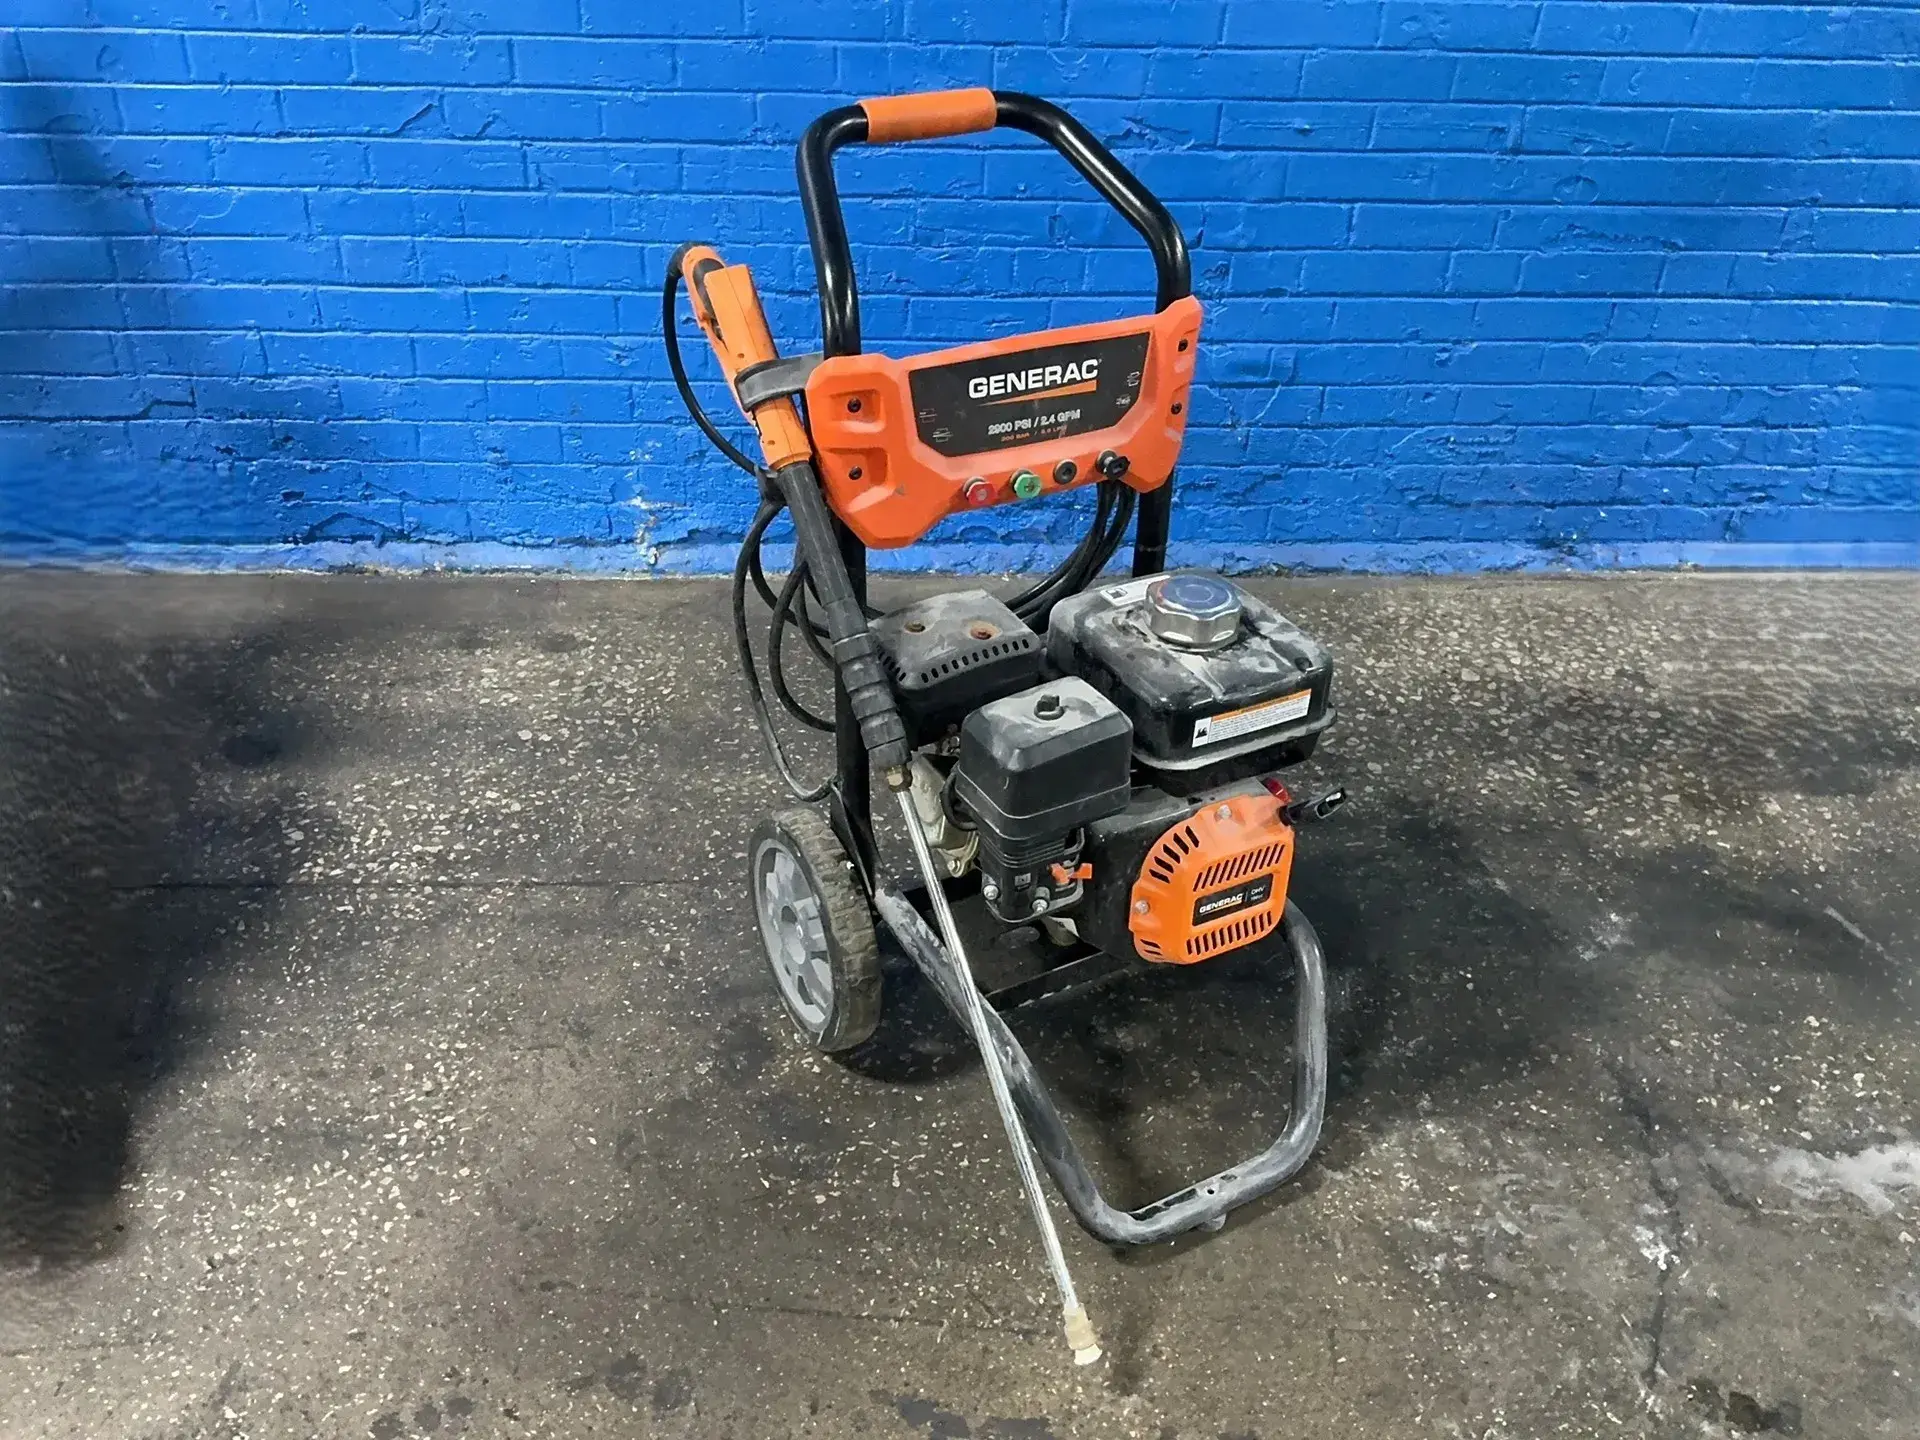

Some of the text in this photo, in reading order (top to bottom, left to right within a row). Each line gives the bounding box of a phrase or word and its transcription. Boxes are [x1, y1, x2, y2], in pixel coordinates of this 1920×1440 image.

[968, 358, 1098, 398] GENERAC
[1014, 418, 1031, 431] PSI
[1033, 416, 1039, 427] /
[1041, 414, 1056, 425] 2.4
[1057, 409, 1081, 422] GPM
[1199, 893, 1243, 913] GENERAC
